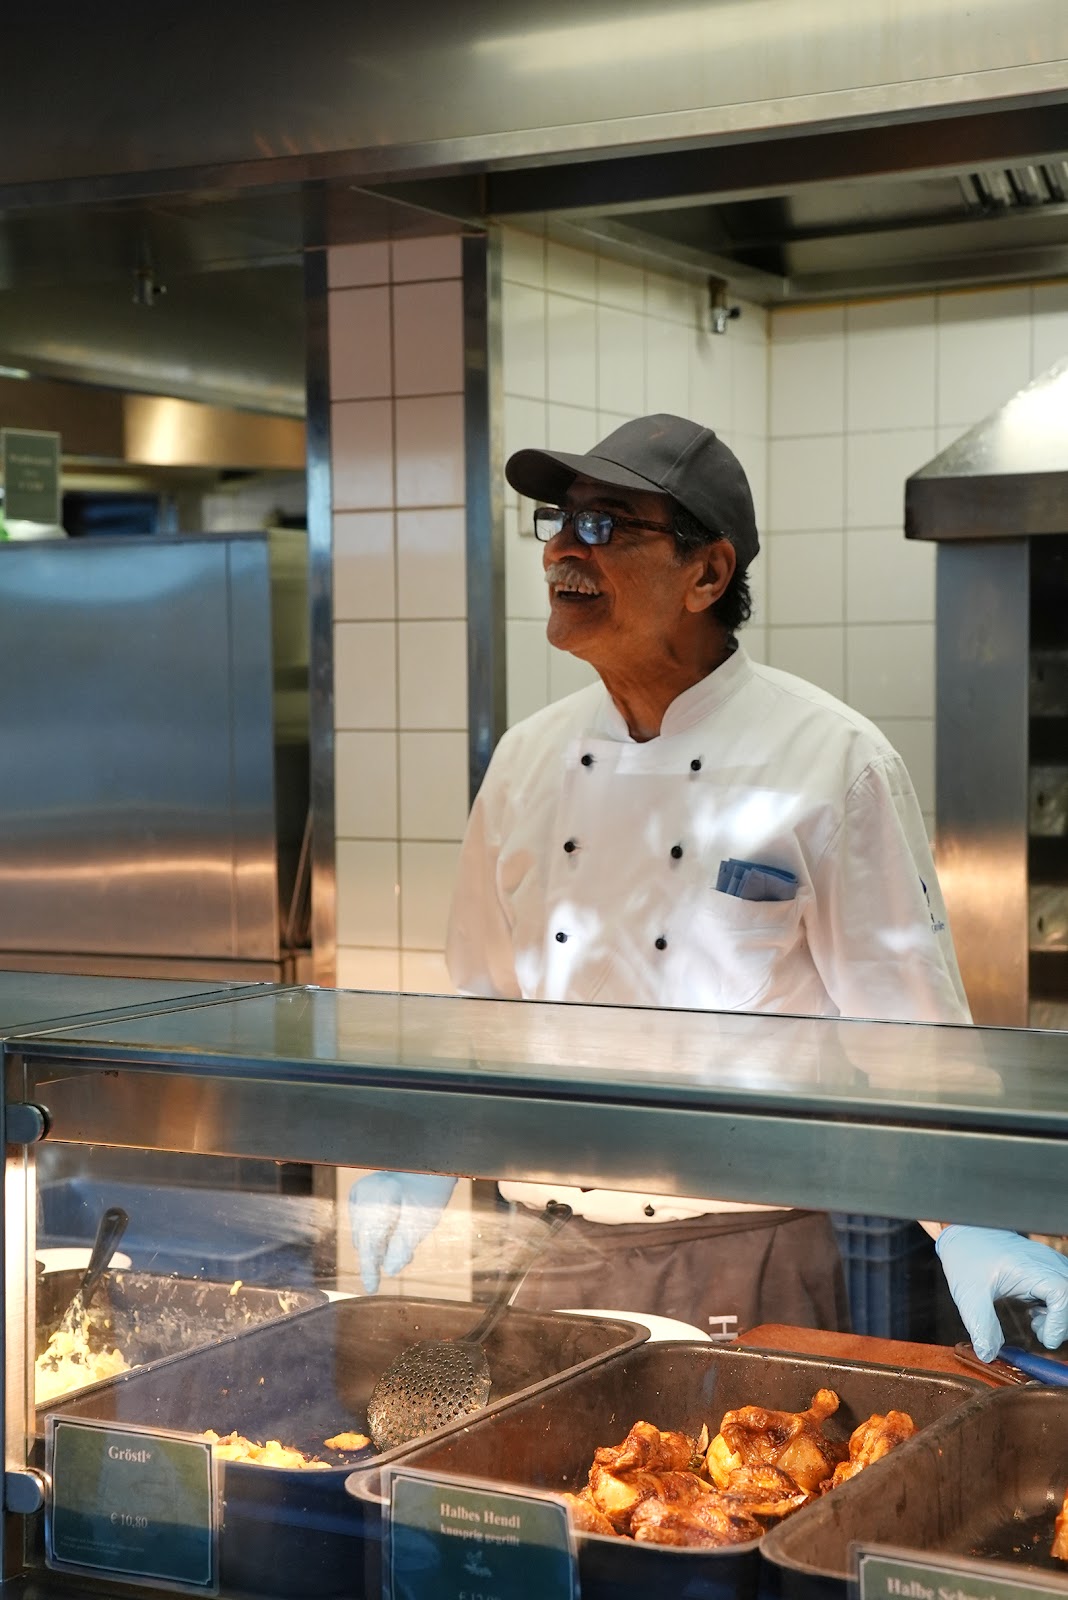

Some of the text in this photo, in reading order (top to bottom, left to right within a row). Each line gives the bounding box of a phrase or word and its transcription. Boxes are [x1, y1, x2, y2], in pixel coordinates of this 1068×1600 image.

[110, 1512, 148, 1529] € 10,80
[440, 1503, 520, 1529] Halbes Hendl
[886, 1576, 934, 1600] Halbe
